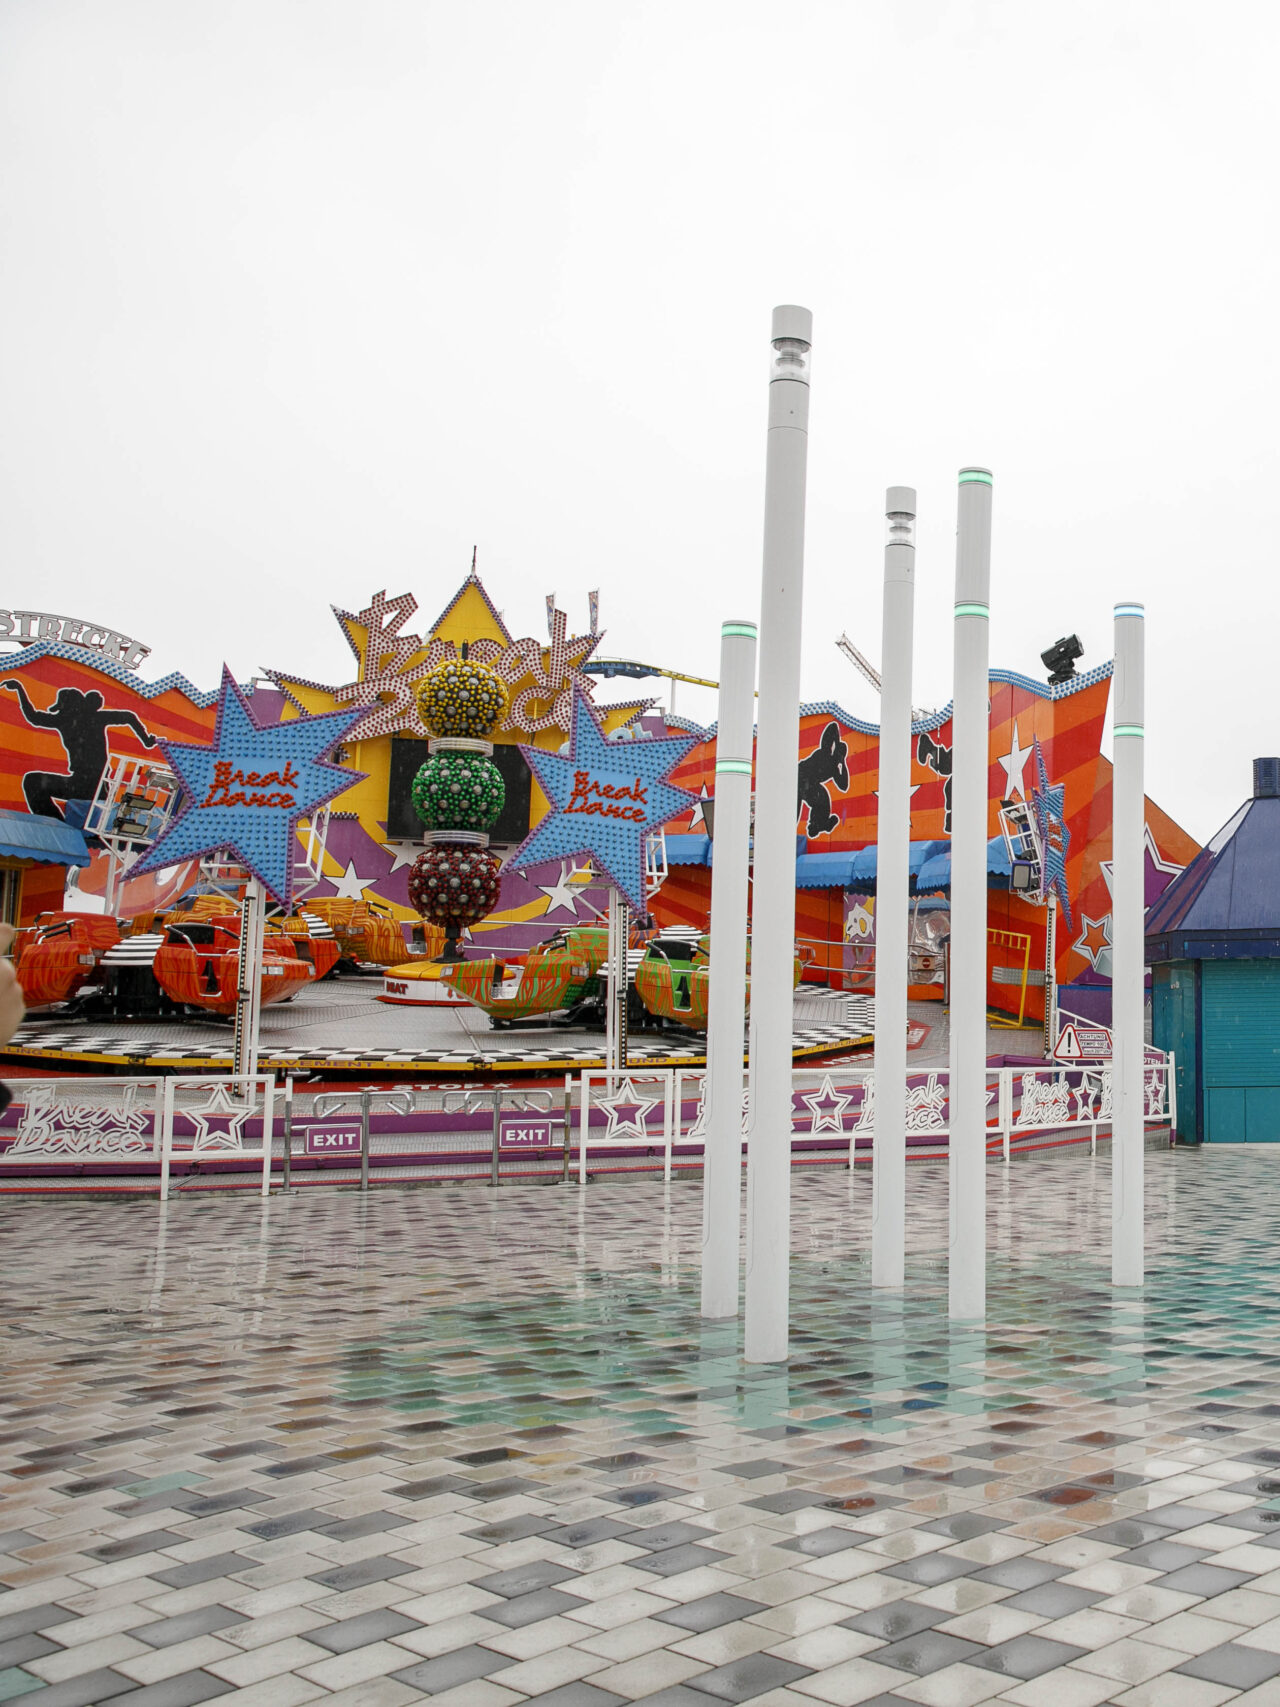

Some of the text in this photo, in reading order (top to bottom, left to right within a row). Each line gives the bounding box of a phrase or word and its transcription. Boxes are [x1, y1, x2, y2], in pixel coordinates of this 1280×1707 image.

[356, 589, 598, 694] Break
[209, 760, 299, 789] Break
[570, 769, 649, 805] Break
[199, 783, 297, 809] Dance
[562, 793, 648, 823] Dance
[391, 1083, 485, 1091] STOP
[1021, 1072, 1070, 1103] Break
[21, 1085, 150, 1131] Break
[6, 1121, 148, 1155] Dance
[313, 1133, 356, 1147] EXIT
[505, 1129, 546, 1141] EXIT
